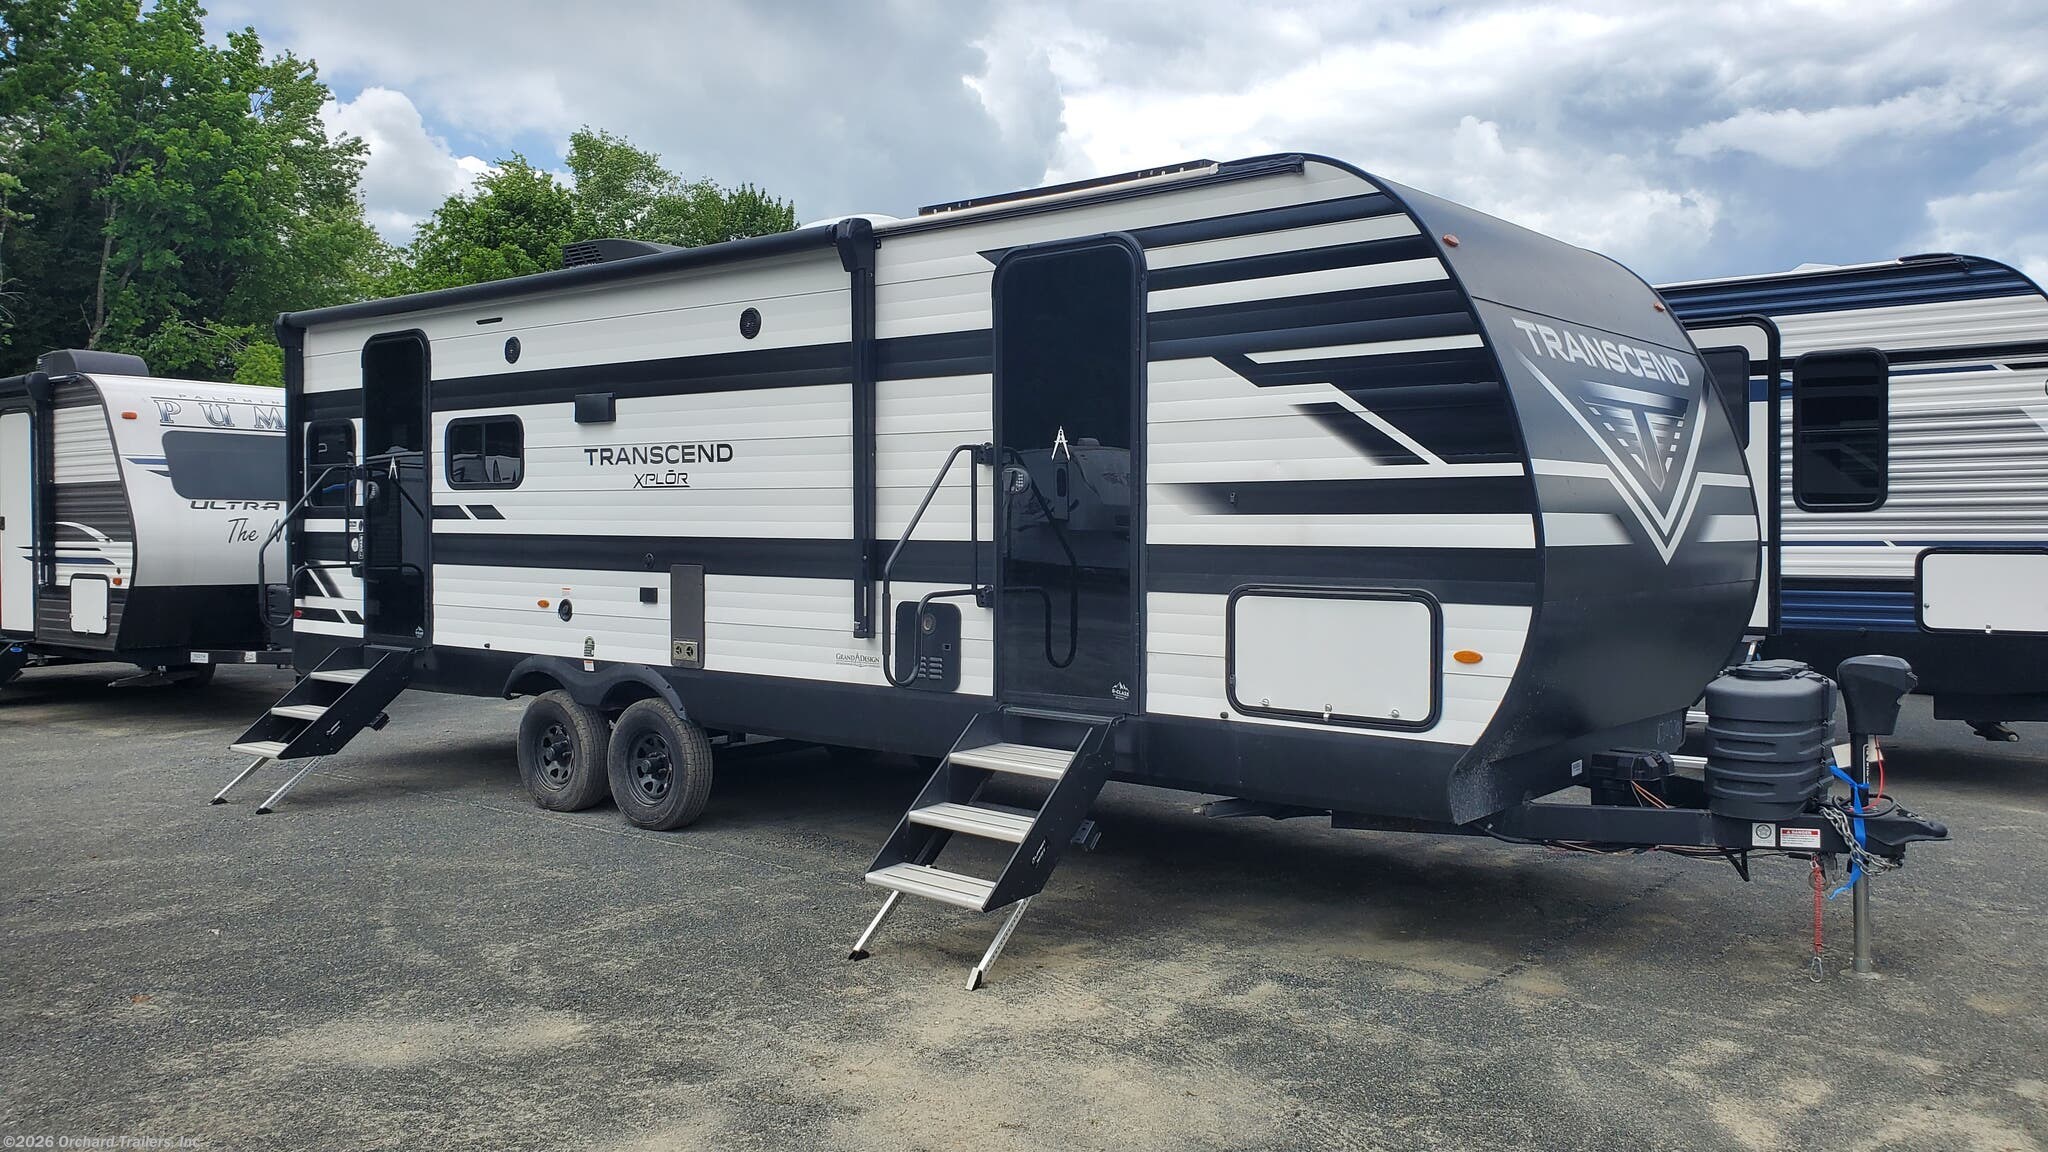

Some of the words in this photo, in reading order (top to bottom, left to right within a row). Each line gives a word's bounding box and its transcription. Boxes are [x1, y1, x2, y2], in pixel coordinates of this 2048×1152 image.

[1511, 317, 1690, 387] TRANSCEND
[583, 443, 733, 466] TRANSCEND
[190, 500, 280, 511] ULTRA
[228, 517, 258, 543] The
